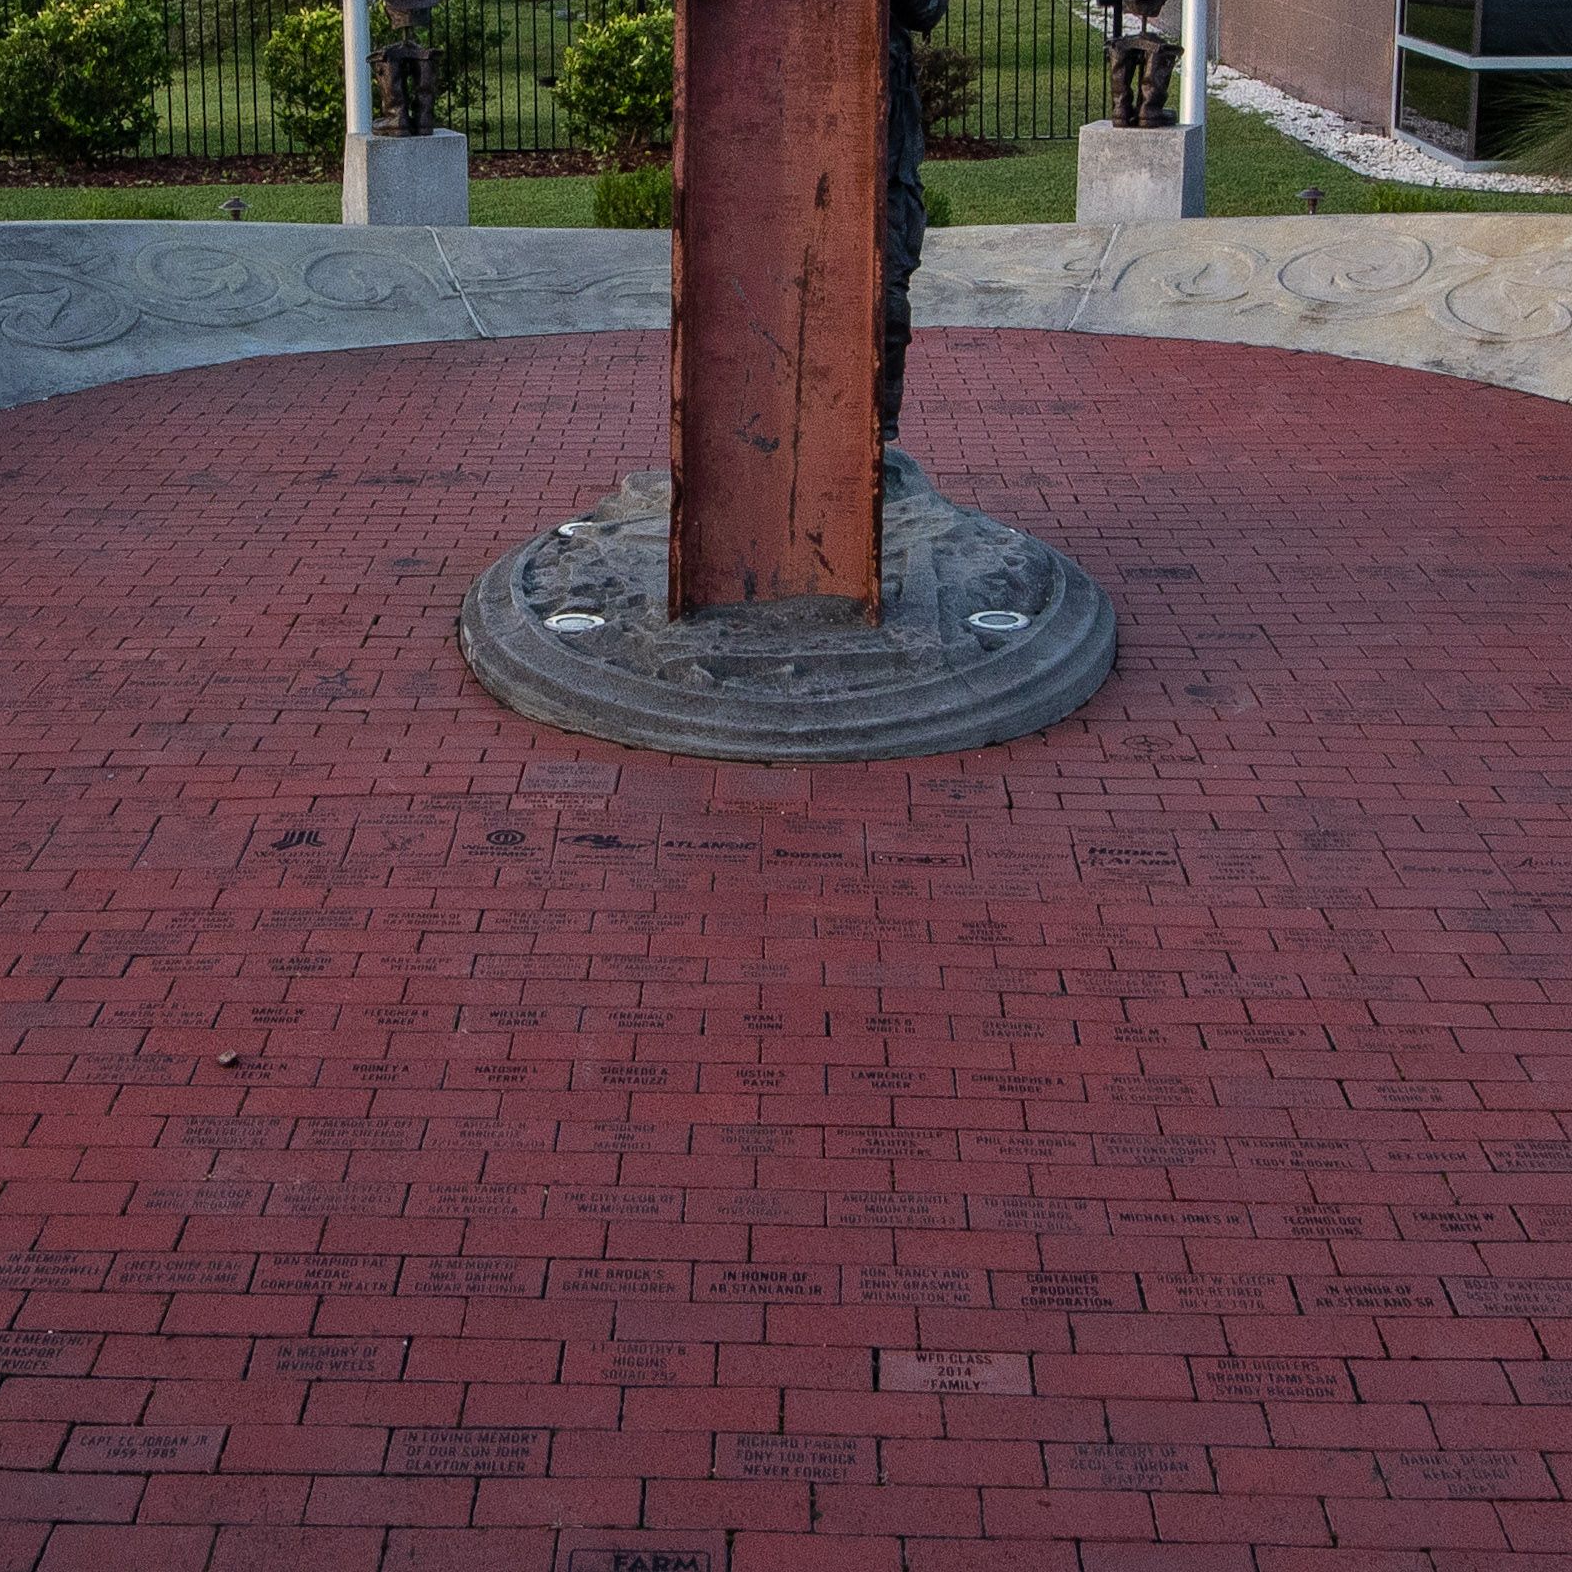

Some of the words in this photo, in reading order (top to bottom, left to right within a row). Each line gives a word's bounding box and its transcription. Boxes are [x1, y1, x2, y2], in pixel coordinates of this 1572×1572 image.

[497, 1019, 539, 1027] GARCIA
[743, 1014, 774, 1022] RYAN
[865, 1017, 900, 1026] JAMES
[1243, 1036, 1290, 1045] RHODES
[487, 1074, 526, 1084] PERRY
[736, 1069, 775, 1079] JUSTIN
[851, 1071, 914, 1081] LAWRENCE
[971, 1073, 1053, 1085] CHRISTOPHER
[998, 1084, 1043, 1094] BRIDGE
[1008, 1137, 1035, 1147] AND
[1298, 1139, 1351, 1149] MEMORY
[563, 1192, 585, 1202] THE
[590, 1192, 617, 1203] CITY
[842, 1194, 894, 1204] ARIZONA
[865, 1204, 930, 1215] MOUNTAIN
[1119, 1212, 1176, 1224] MICHAEL
[1181, 1214, 1222, 1225] JONES
[1226, 1215, 1240, 1225] JR
[1282, 1215, 1363, 1226] TECHNOLOGY
[1412, 1211, 1478, 1222] FRANKLIN
[1439, 1222, 1483, 1233] SMITH
[303, 1256, 359, 1267] SHAPIRO
[167, 1272, 196, 1284] AND
[576, 1267, 601, 1279] THE
[605, 1268, 665, 1280] BROCK'S
[722, 1270, 737, 1281] IN
[741, 1270, 788, 1282] HONOR
[791, 1271, 809, 1283] OF
[943, 1270, 970, 1281] AND
[1027, 1273, 1100, 1285] CONTAINER
[259, 1280, 333, 1291] CORPORATE
[337, 1281, 388, 1292] HEALTH
[561, 1280, 676, 1293] GRANDCHILDREN
[859, 1279, 898, 1290] JENNY
[1030, 1284, 1100, 1297] PRODUCTS
[1324, 1284, 1340, 1296] IN
[1343, 1284, 1393, 1296] HONOR
[1395, 1285, 1413, 1297] OF
[1207, 1287, 1263, 1299] RETIRED
[1020, 1296, 1114, 1308] CORPORATION
[14, 1333, 95, 1347] EMERGENCY
[277, 1345, 292, 1358] IN
[296, 1346, 357, 1358] MEMORY
[363, 1346, 379, 1358] OF
[275, 1359, 324, 1371] IRVING
[329, 1360, 376, 1372] WELLS
[613, 1356, 668, 1368] HIGGINS
[916, 1353, 944, 1365] WFD
[949, 1354, 993, 1366] CLASS
[937, 1366, 972, 1378] 2014
[1205, 1372, 1263, 1385] BRANDY
[79, 1435, 112, 1447] CAPT
[140, 1434, 189, 1447] JORDAN
[193, 1434, 208, 1446] JR
[402, 1431, 418, 1444] IN
[423, 1431, 472, 1444] LOVING
[477, 1432, 539, 1445] MEMORY
[736, 1436, 800, 1449] RICHARD
[405, 1445, 422, 1458] OF
[428, 1446, 457, 1458] OUR
[461, 1446, 491, 1459] SON
[494, 1446, 531, 1459] JOHN
[735, 1449, 773, 1462] FDNY
[811, 1452, 858, 1465] TRUCK
[1095, 1444, 1154, 1458] MEMORY
[404, 1459, 470, 1472] CLAYTON
[473, 1460, 527, 1473] MILLER
[743, 1464, 790, 1477] NEVER
[794, 1466, 849, 1479] FORGET
[1069, 1458, 1107, 1471] CECIL
[1132, 1460, 1190, 1473] JORDAN
